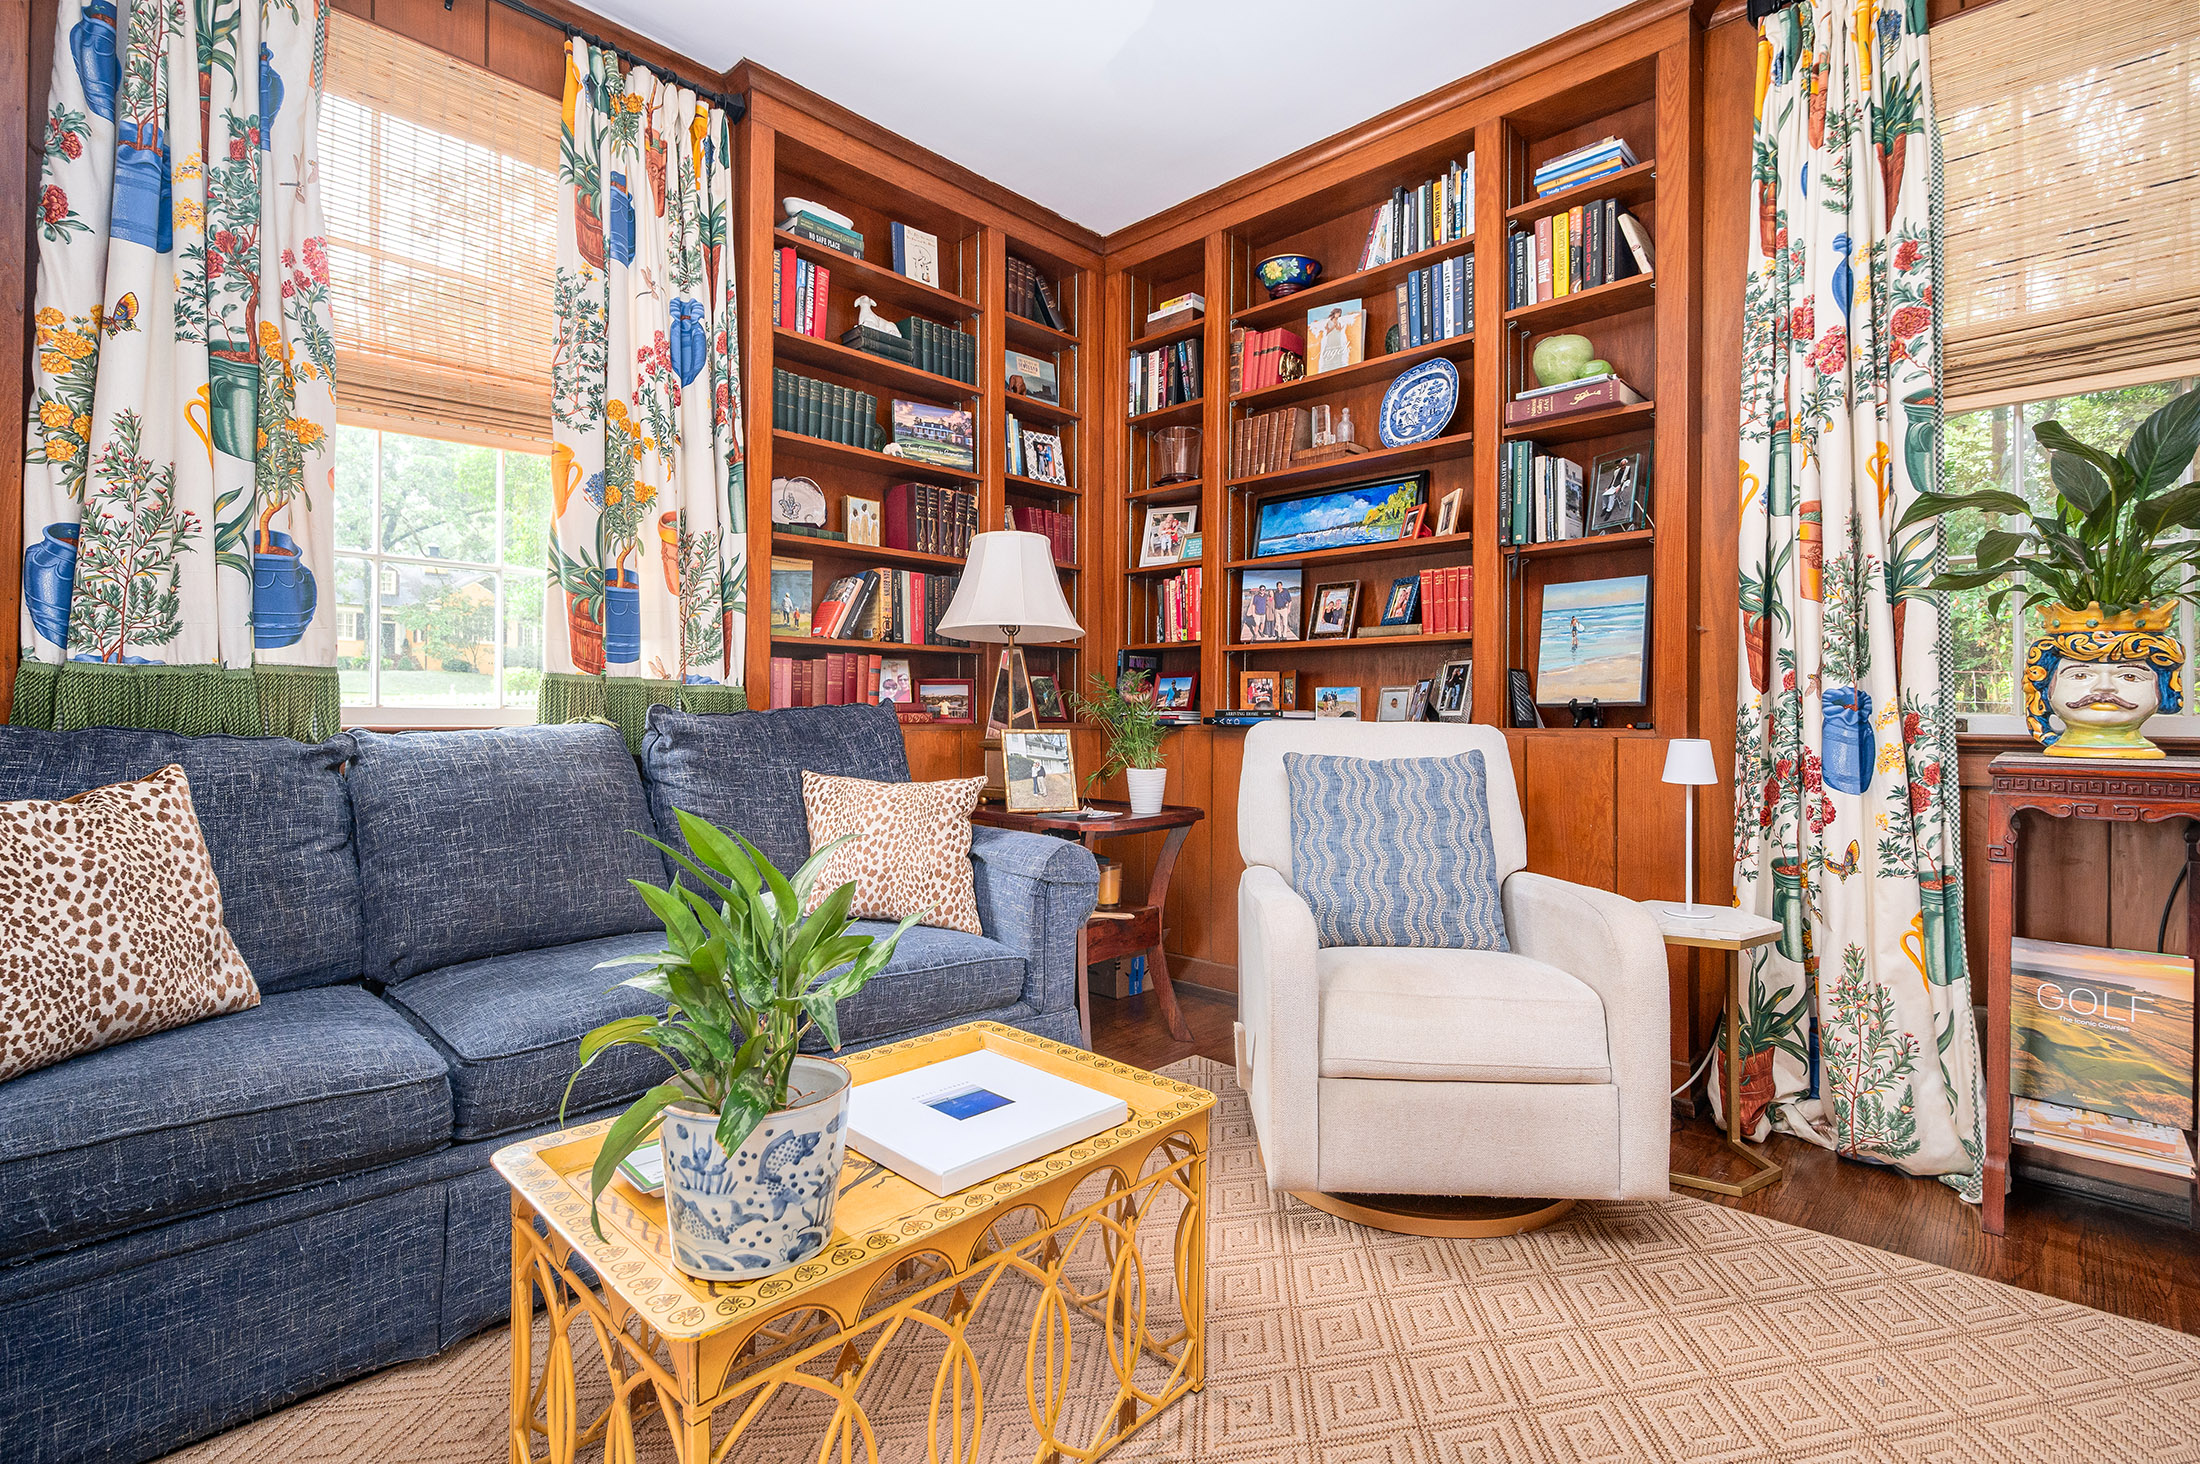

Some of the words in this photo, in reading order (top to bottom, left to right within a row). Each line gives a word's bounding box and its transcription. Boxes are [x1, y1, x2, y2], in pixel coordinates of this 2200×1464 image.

[808, 231, 816, 241] NO
[816, 234, 827, 245] SAFE
[827, 239, 841, 251] PLACE
[1586, 254, 1591, 263] OF
[1538, 258, 1550, 284] Stiffed
[807, 271, 815, 298] HARLAN
[806, 298, 814, 318] COBEN
[1311, 340, 1352, 361] Angels
[2037, 983, 2154, 1023] GOLF
[2059, 1015, 2073, 1023] The
[2074, 1017, 2097, 1028] Iconic
[2098, 1022, 2130, 1033] Courses
